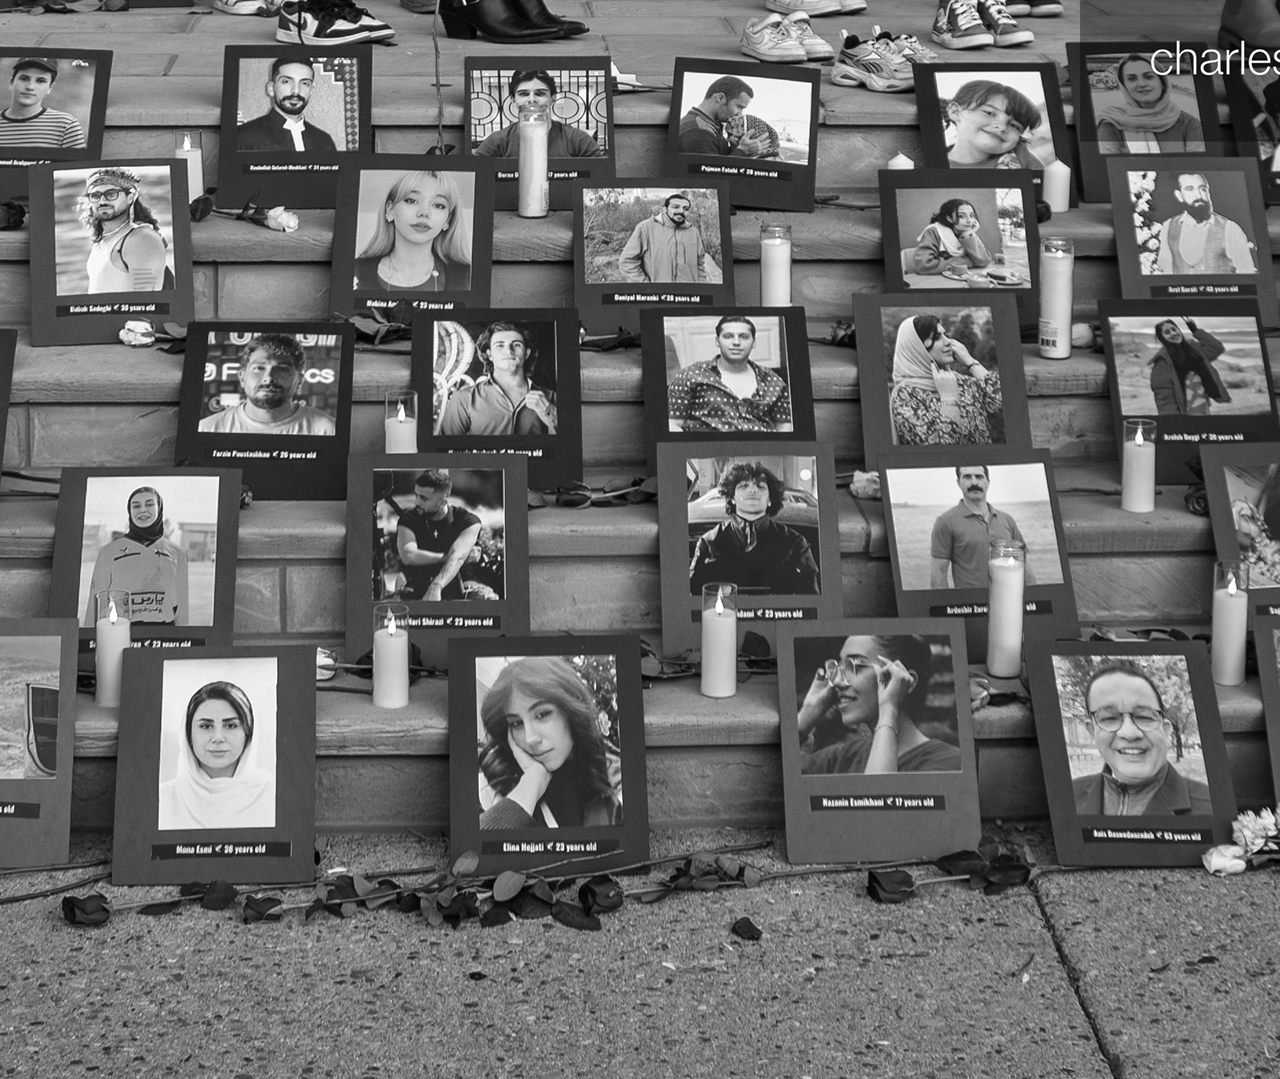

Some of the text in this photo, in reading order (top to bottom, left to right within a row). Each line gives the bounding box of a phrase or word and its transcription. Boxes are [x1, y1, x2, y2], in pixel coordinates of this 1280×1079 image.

[754, 169, 779, 178] years old
[675, 295, 701, 304] years old
[129, 303, 156, 314] years old
[1218, 433, 1245, 442] years old
[464, 618, 482, 628] years
[481, 617, 494, 627] old
[822, 797, 849, 808] Nazanin
[849, 797, 885, 808] Esmikhani
[903, 798, 922, 809] years
[922, 796, 935, 808] old
[3, 804, 16, 814] old
[1173, 831, 1203, 842] years old
[175, 844, 195, 856] Mona
[234, 845, 254, 856] years
[254, 844, 267, 854] old
[502, 841, 598, 854] Elina Hojjati 23 years old
